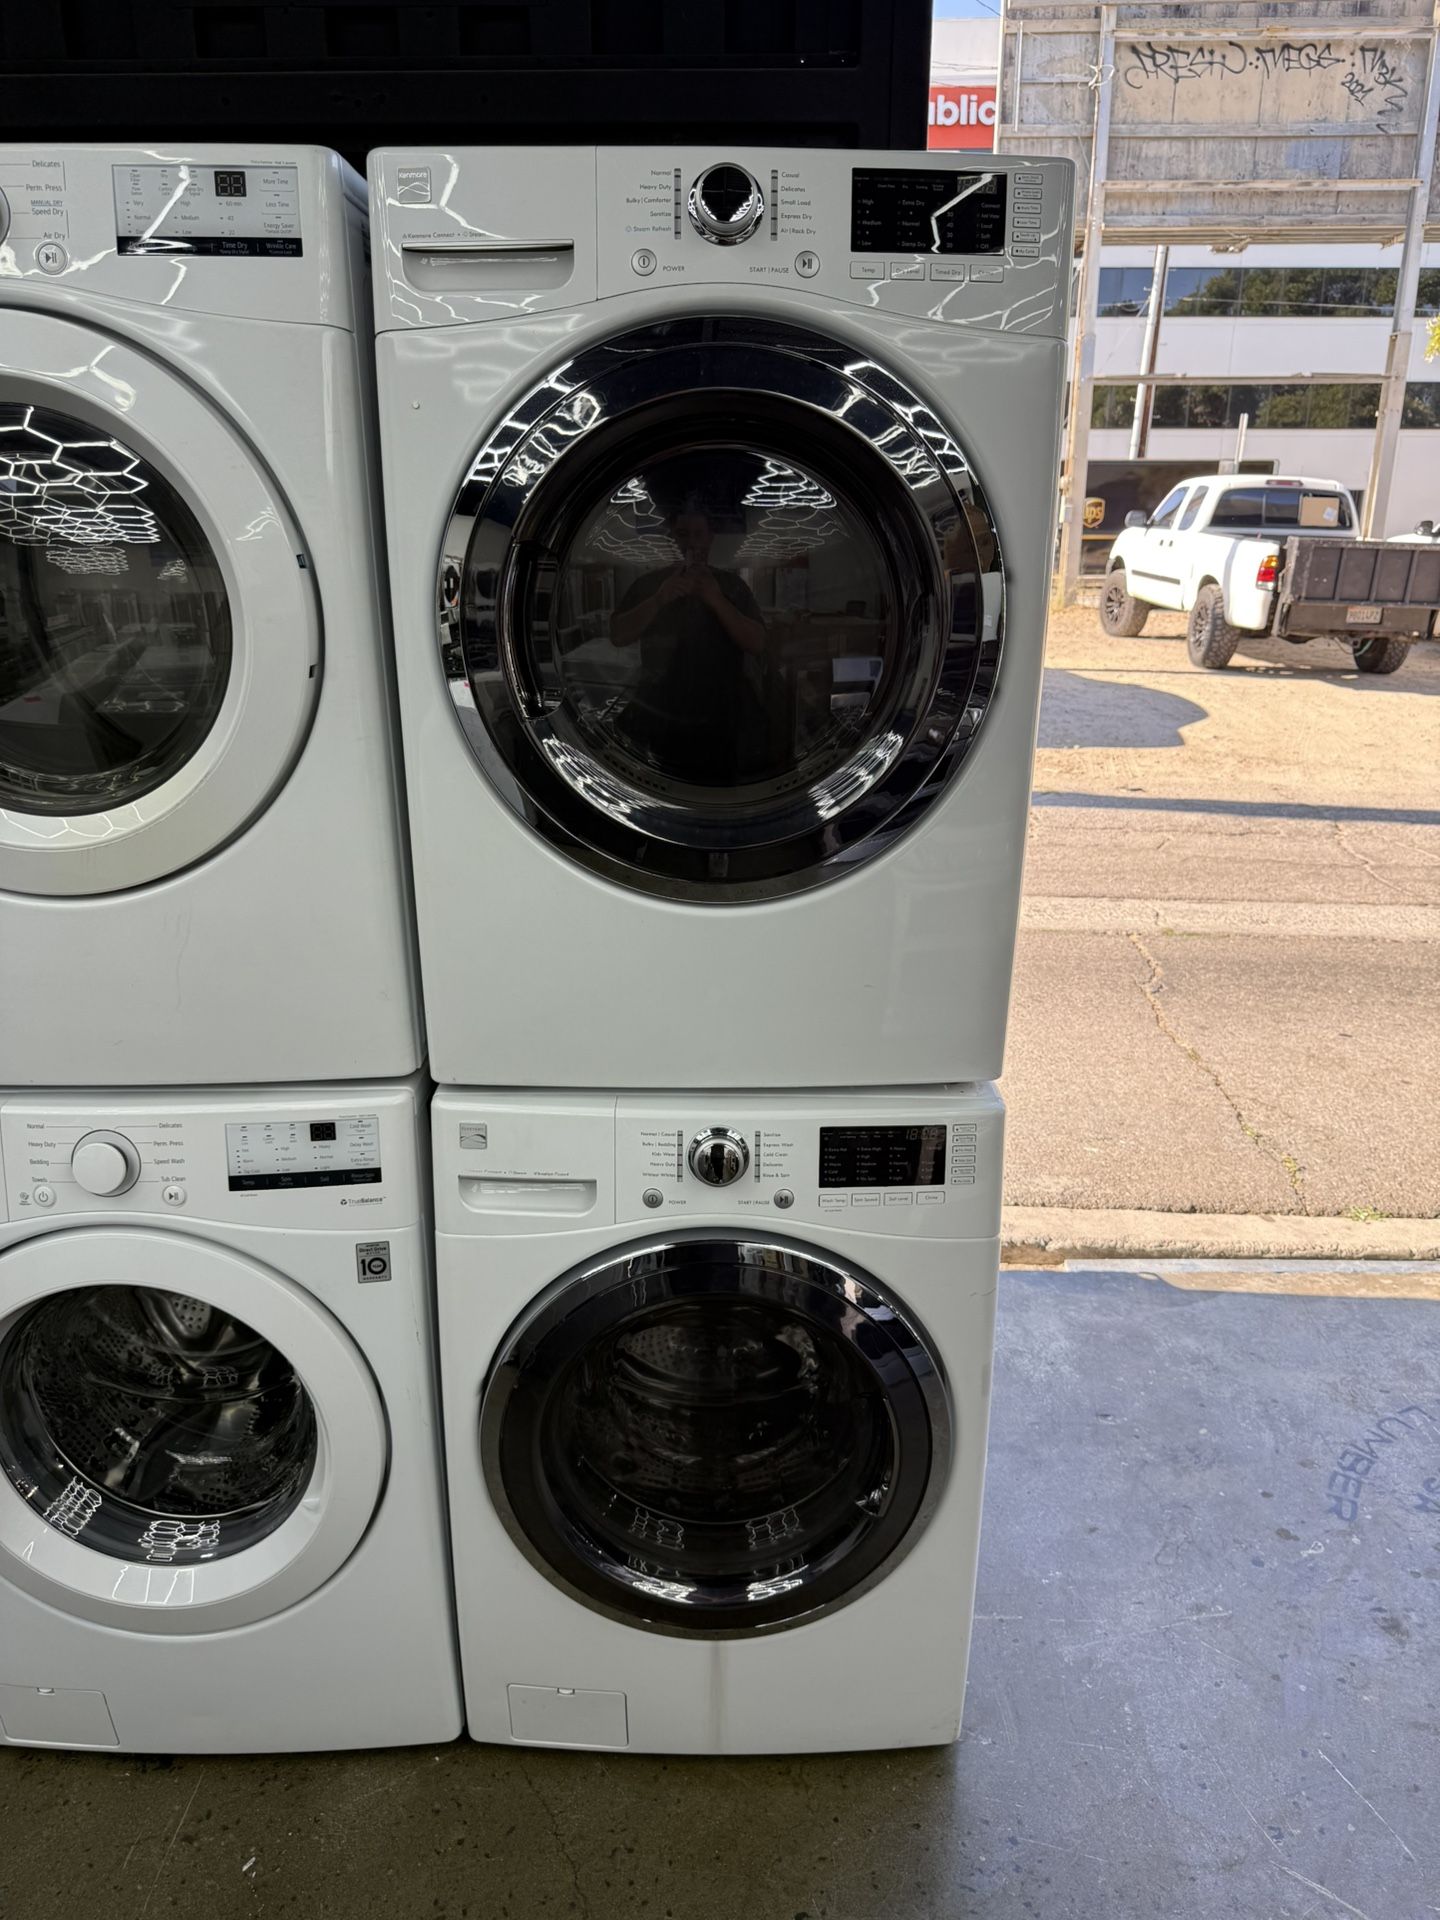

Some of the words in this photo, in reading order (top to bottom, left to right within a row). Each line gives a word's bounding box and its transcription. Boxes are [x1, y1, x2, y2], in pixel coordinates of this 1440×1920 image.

[32, 208, 51, 216] Speed
[54, 232, 66, 240] Dry
[806, 228, 816, 236] Dry
[236, 242, 248, 250] Dry
[361, 1257, 387, 1276] 10
[1326, 1405, 1437, 1522] LUMBER
